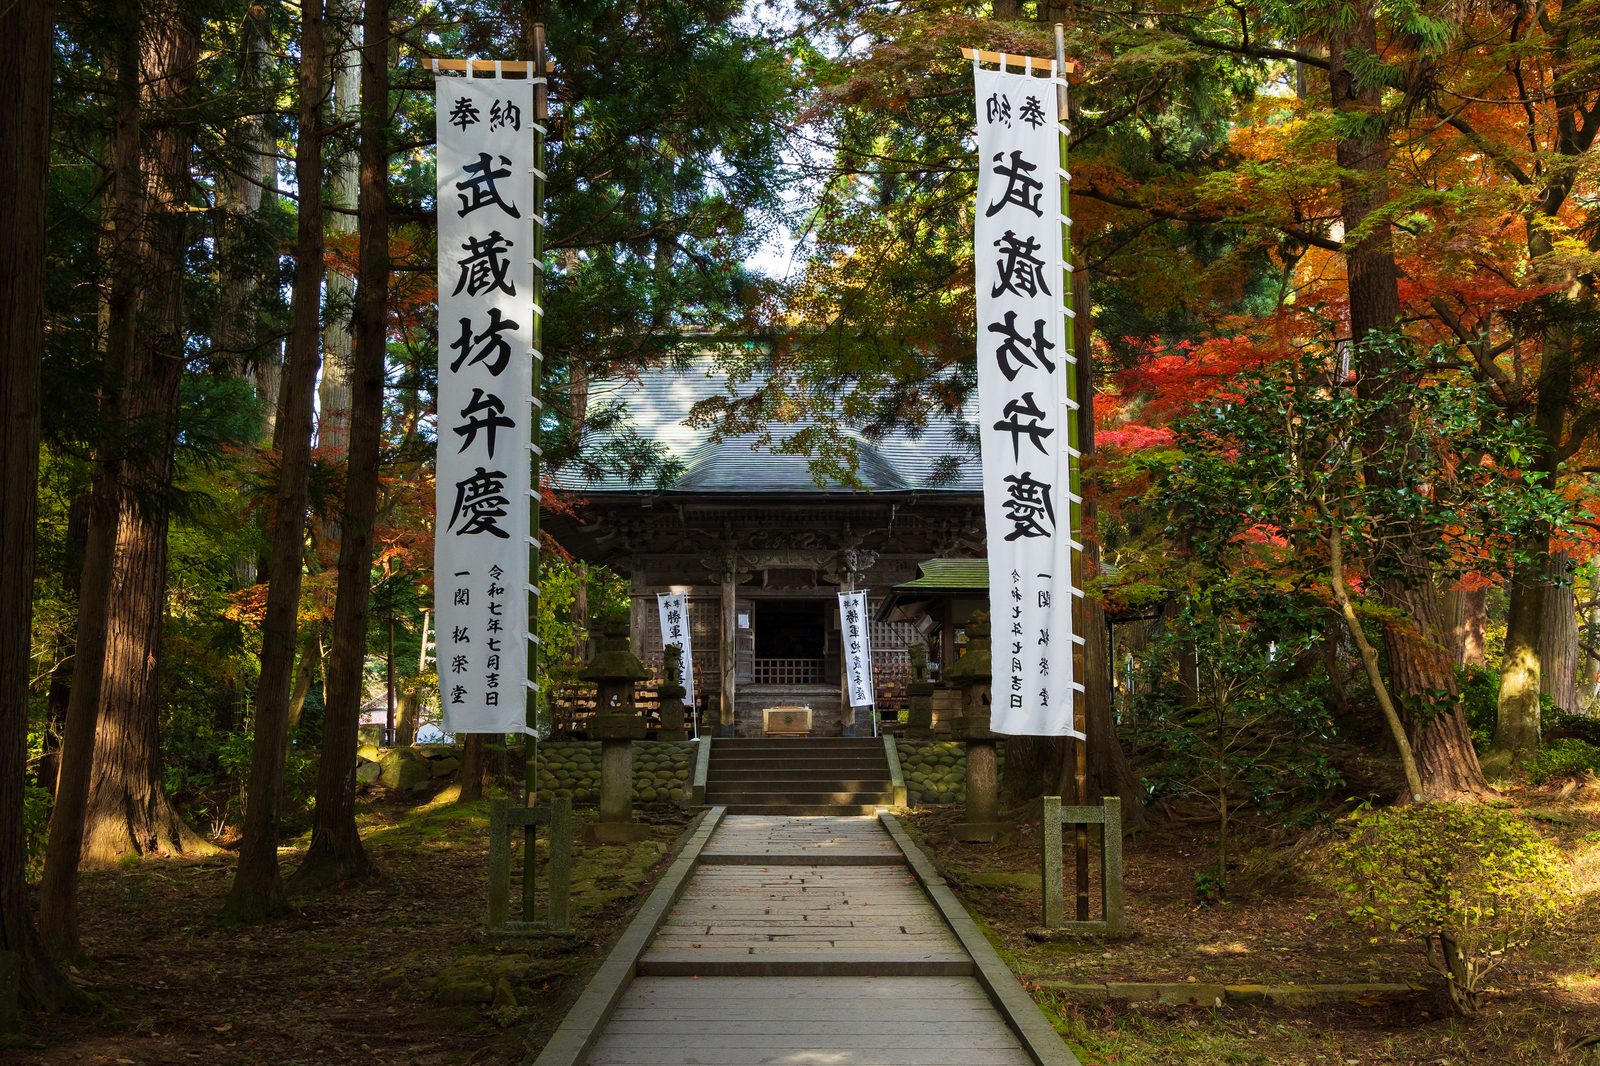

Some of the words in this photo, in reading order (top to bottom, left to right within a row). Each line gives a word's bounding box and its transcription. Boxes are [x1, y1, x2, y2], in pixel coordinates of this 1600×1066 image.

[449, 97, 521, 133] 奉納
[446, 152, 521, 539] 武蔵坊弁慶
[485, 564, 505, 707] 令和七年七月吉日
